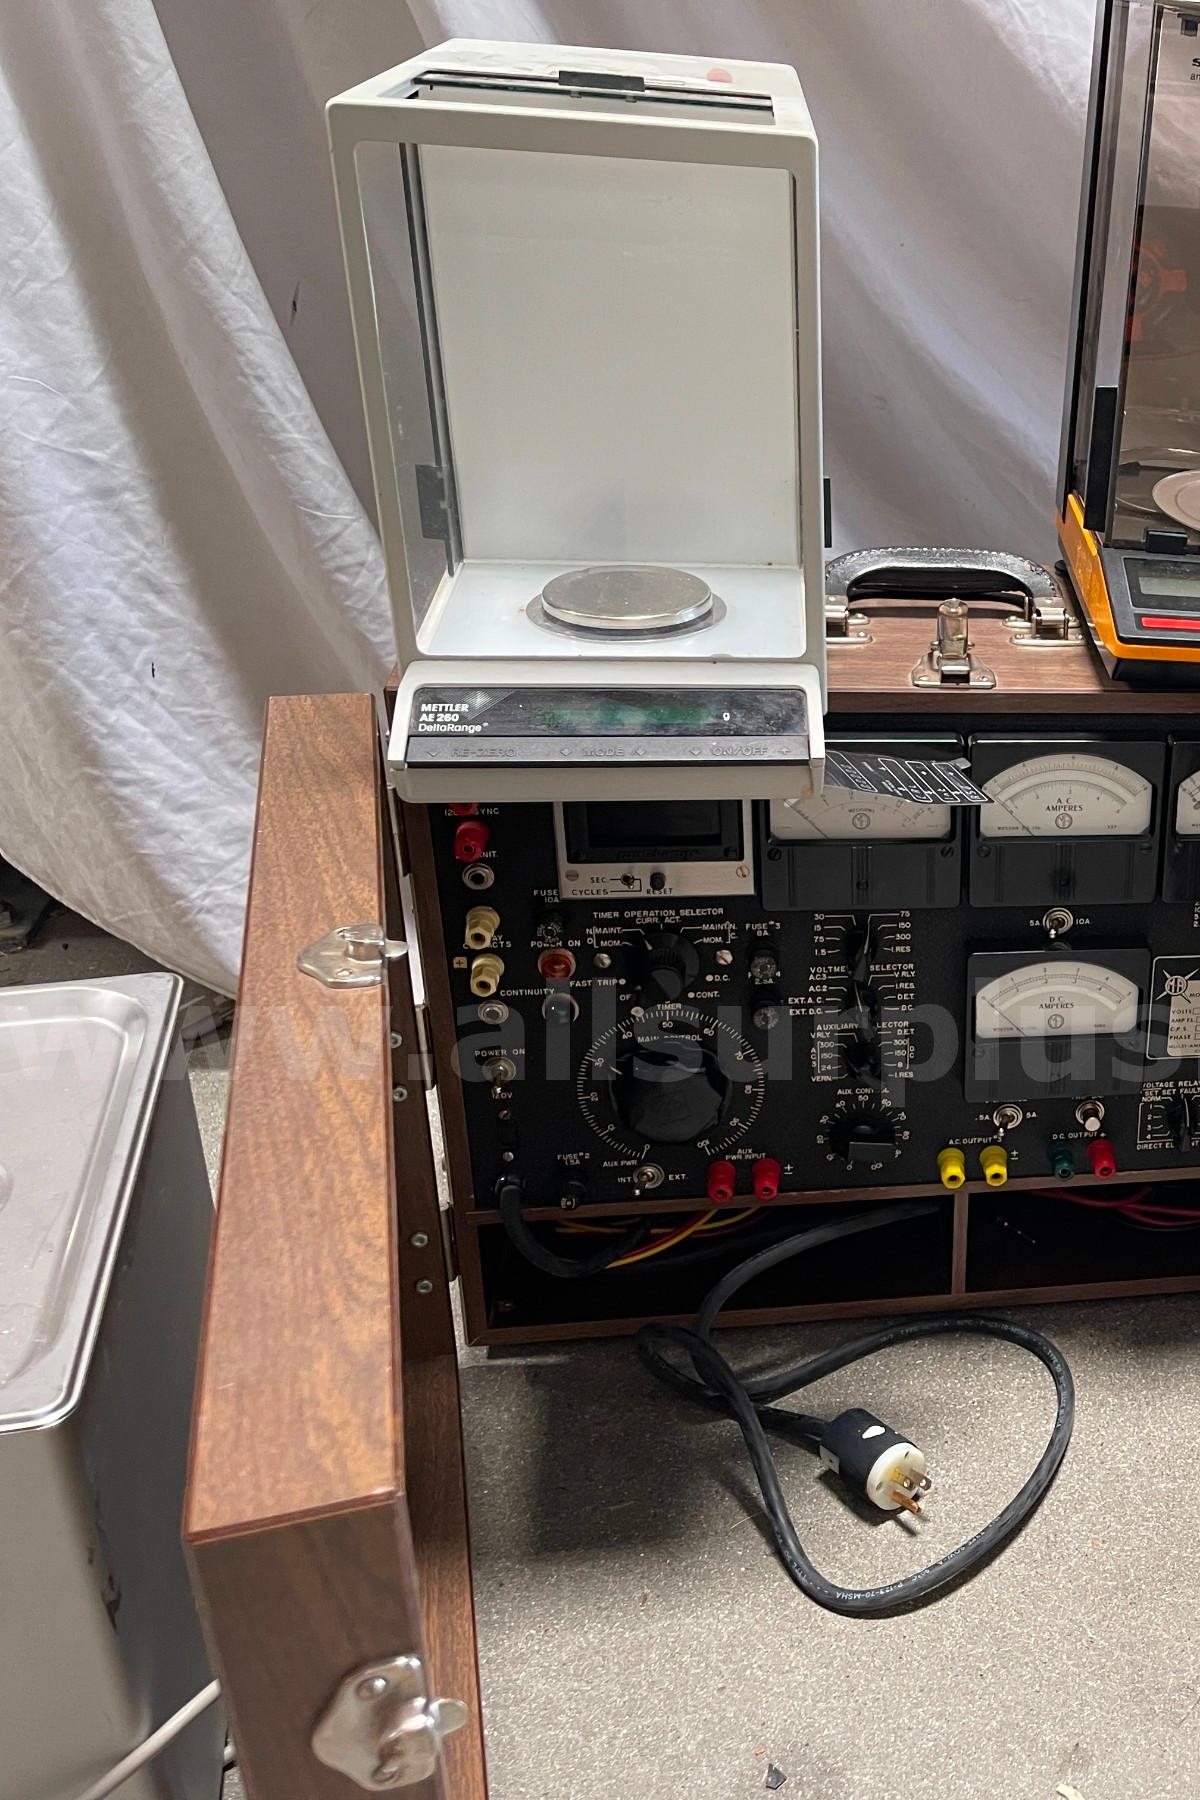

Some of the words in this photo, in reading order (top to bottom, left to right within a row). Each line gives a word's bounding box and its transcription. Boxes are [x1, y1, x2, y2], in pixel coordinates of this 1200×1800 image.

[421, 703, 469, 712] METTLER
[419, 713, 435, 722] AE
[436, 713, 460, 722] 260
[418, 723, 482, 734] DeltaRange
[711, 746, 769, 756] ON/OFF
[1045, 804, 1084, 812] AMPERES
[590, 876, 608, 884] SEC
[533, 889, 559, 897] FUSE
[571, 888, 609, 896] CYCLES
[646, 887, 673, 895] RESET
[544, 896, 560, 904] 10A
[592, 911, 620, 919] TIMER
[624, 909, 676, 919] OPERATION
[679, 907, 724, 916] SELECTOR
[900, 910, 911, 918] 75
[745, 922, 768, 931] FUSE
[813, 924, 822, 932] 15
[809, 965, 848, 974] VOLTME
[869, 963, 914, 971] SELECTOR
[569, 979, 593, 988] FAST
[597, 978, 618, 986] TRIP
[499, 988, 555, 997] CONTINUITY
[696, 990, 721, 999] CONT.
[656, 1002, 682, 1011] TIMER
[1038, 1002, 1075, 1010] AMPERES
[661, 1020, 674, 1029] 50
[816, 1022, 859, 1032] AUXILIARY
[621, 1030, 633, 1040] 40
[703, 1026, 715, 1037] 60
[474, 1049, 508, 1057] POWER
[512, 1048, 526, 1056] ON
[1161, 1088, 1177, 1096] SET
[1067, 1131, 1098, 1139] OUTPUT
[963, 1136, 993, 1145] OUTPUT
[1136, 1142, 1163, 1150] DIRECT
[737, 1147, 753, 1155] AUX
[556, 1152, 578, 1161] FUSE
[743, 1152, 766, 1160] INPUT
[620, 1159, 638, 1167] PWR
